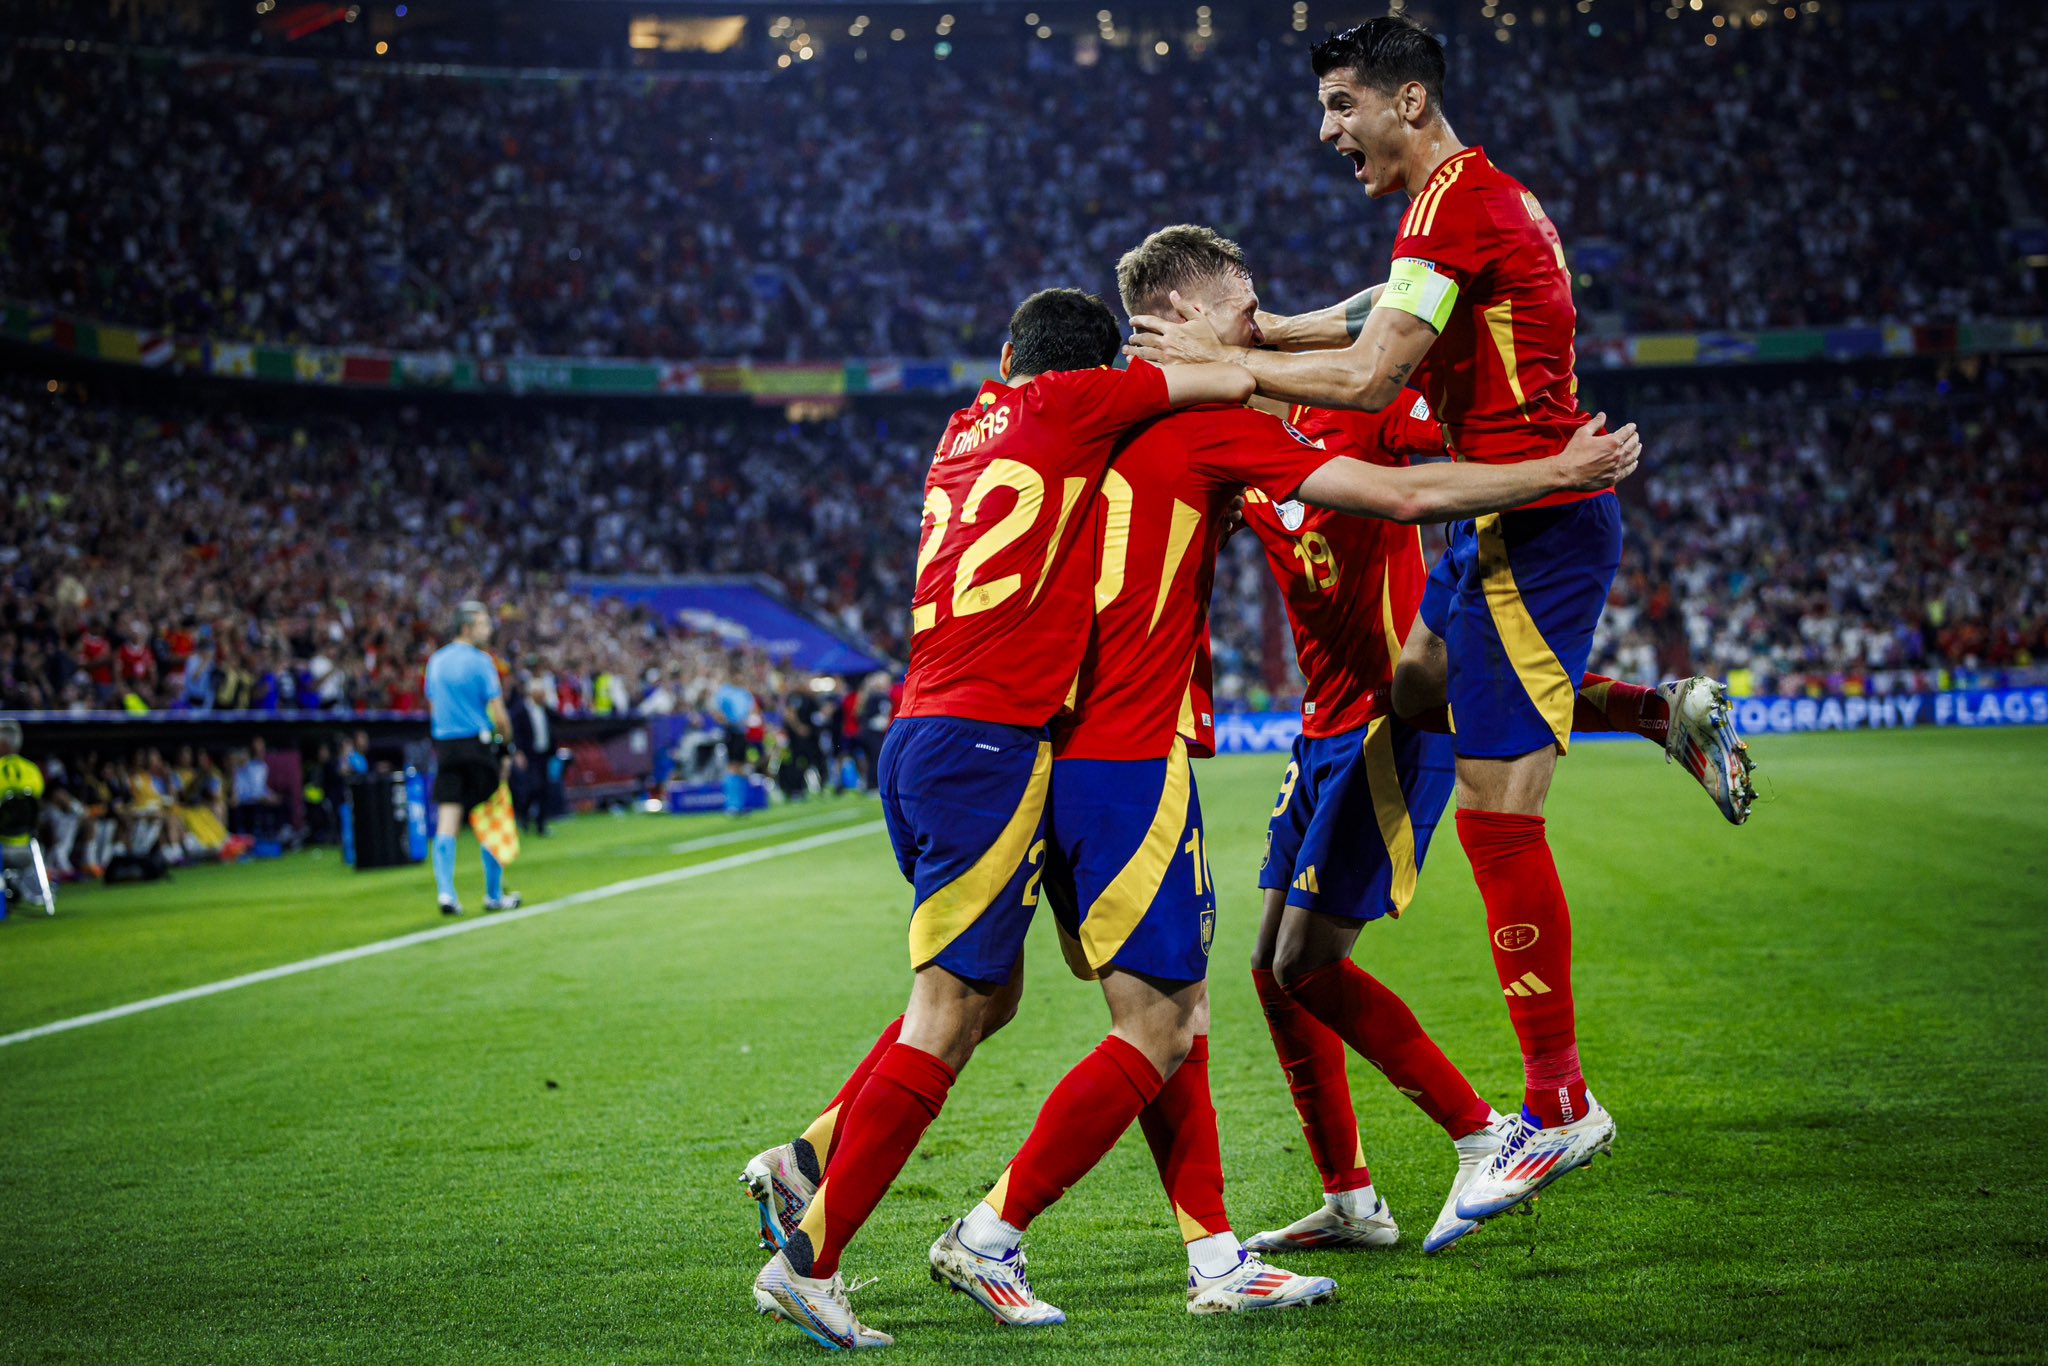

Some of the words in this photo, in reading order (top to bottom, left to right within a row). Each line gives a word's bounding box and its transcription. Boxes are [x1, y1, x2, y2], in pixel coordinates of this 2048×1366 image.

[948, 405, 1010, 458] NAVAS
[912, 458, 1045, 635] 22
[1293, 531, 1339, 592] 19
[1934, 690, 2048, 726] FLAGS
